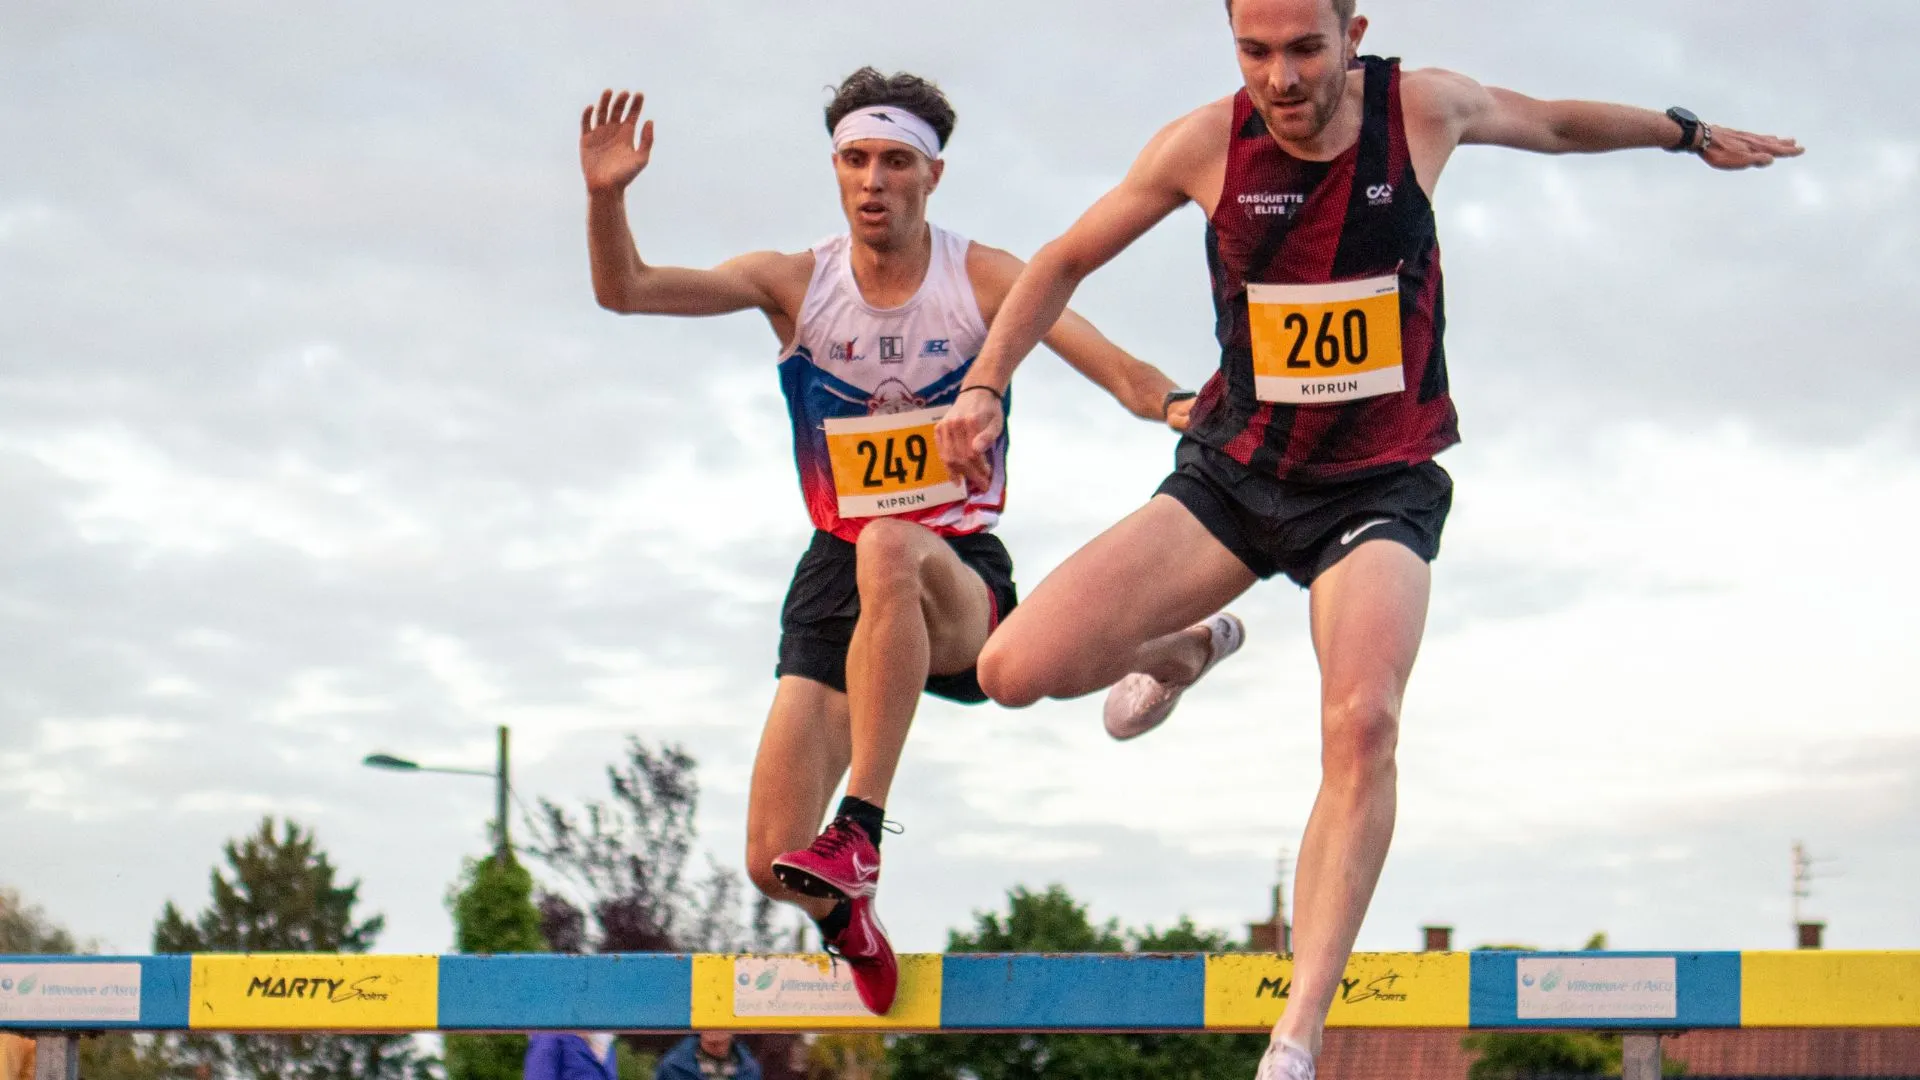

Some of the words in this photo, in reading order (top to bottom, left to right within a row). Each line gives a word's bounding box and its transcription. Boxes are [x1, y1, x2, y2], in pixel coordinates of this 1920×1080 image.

[1238, 192, 1303, 204] CASQUETTE
[1255, 205, 1285, 215] ELITE
[1284, 308, 1369, 369] 260
[1301, 380, 1358, 396] KIPRUN
[857, 434, 928, 488] 249
[877, 493, 926, 509] KIPRUN
[246, 976, 345, 999] MARTY
